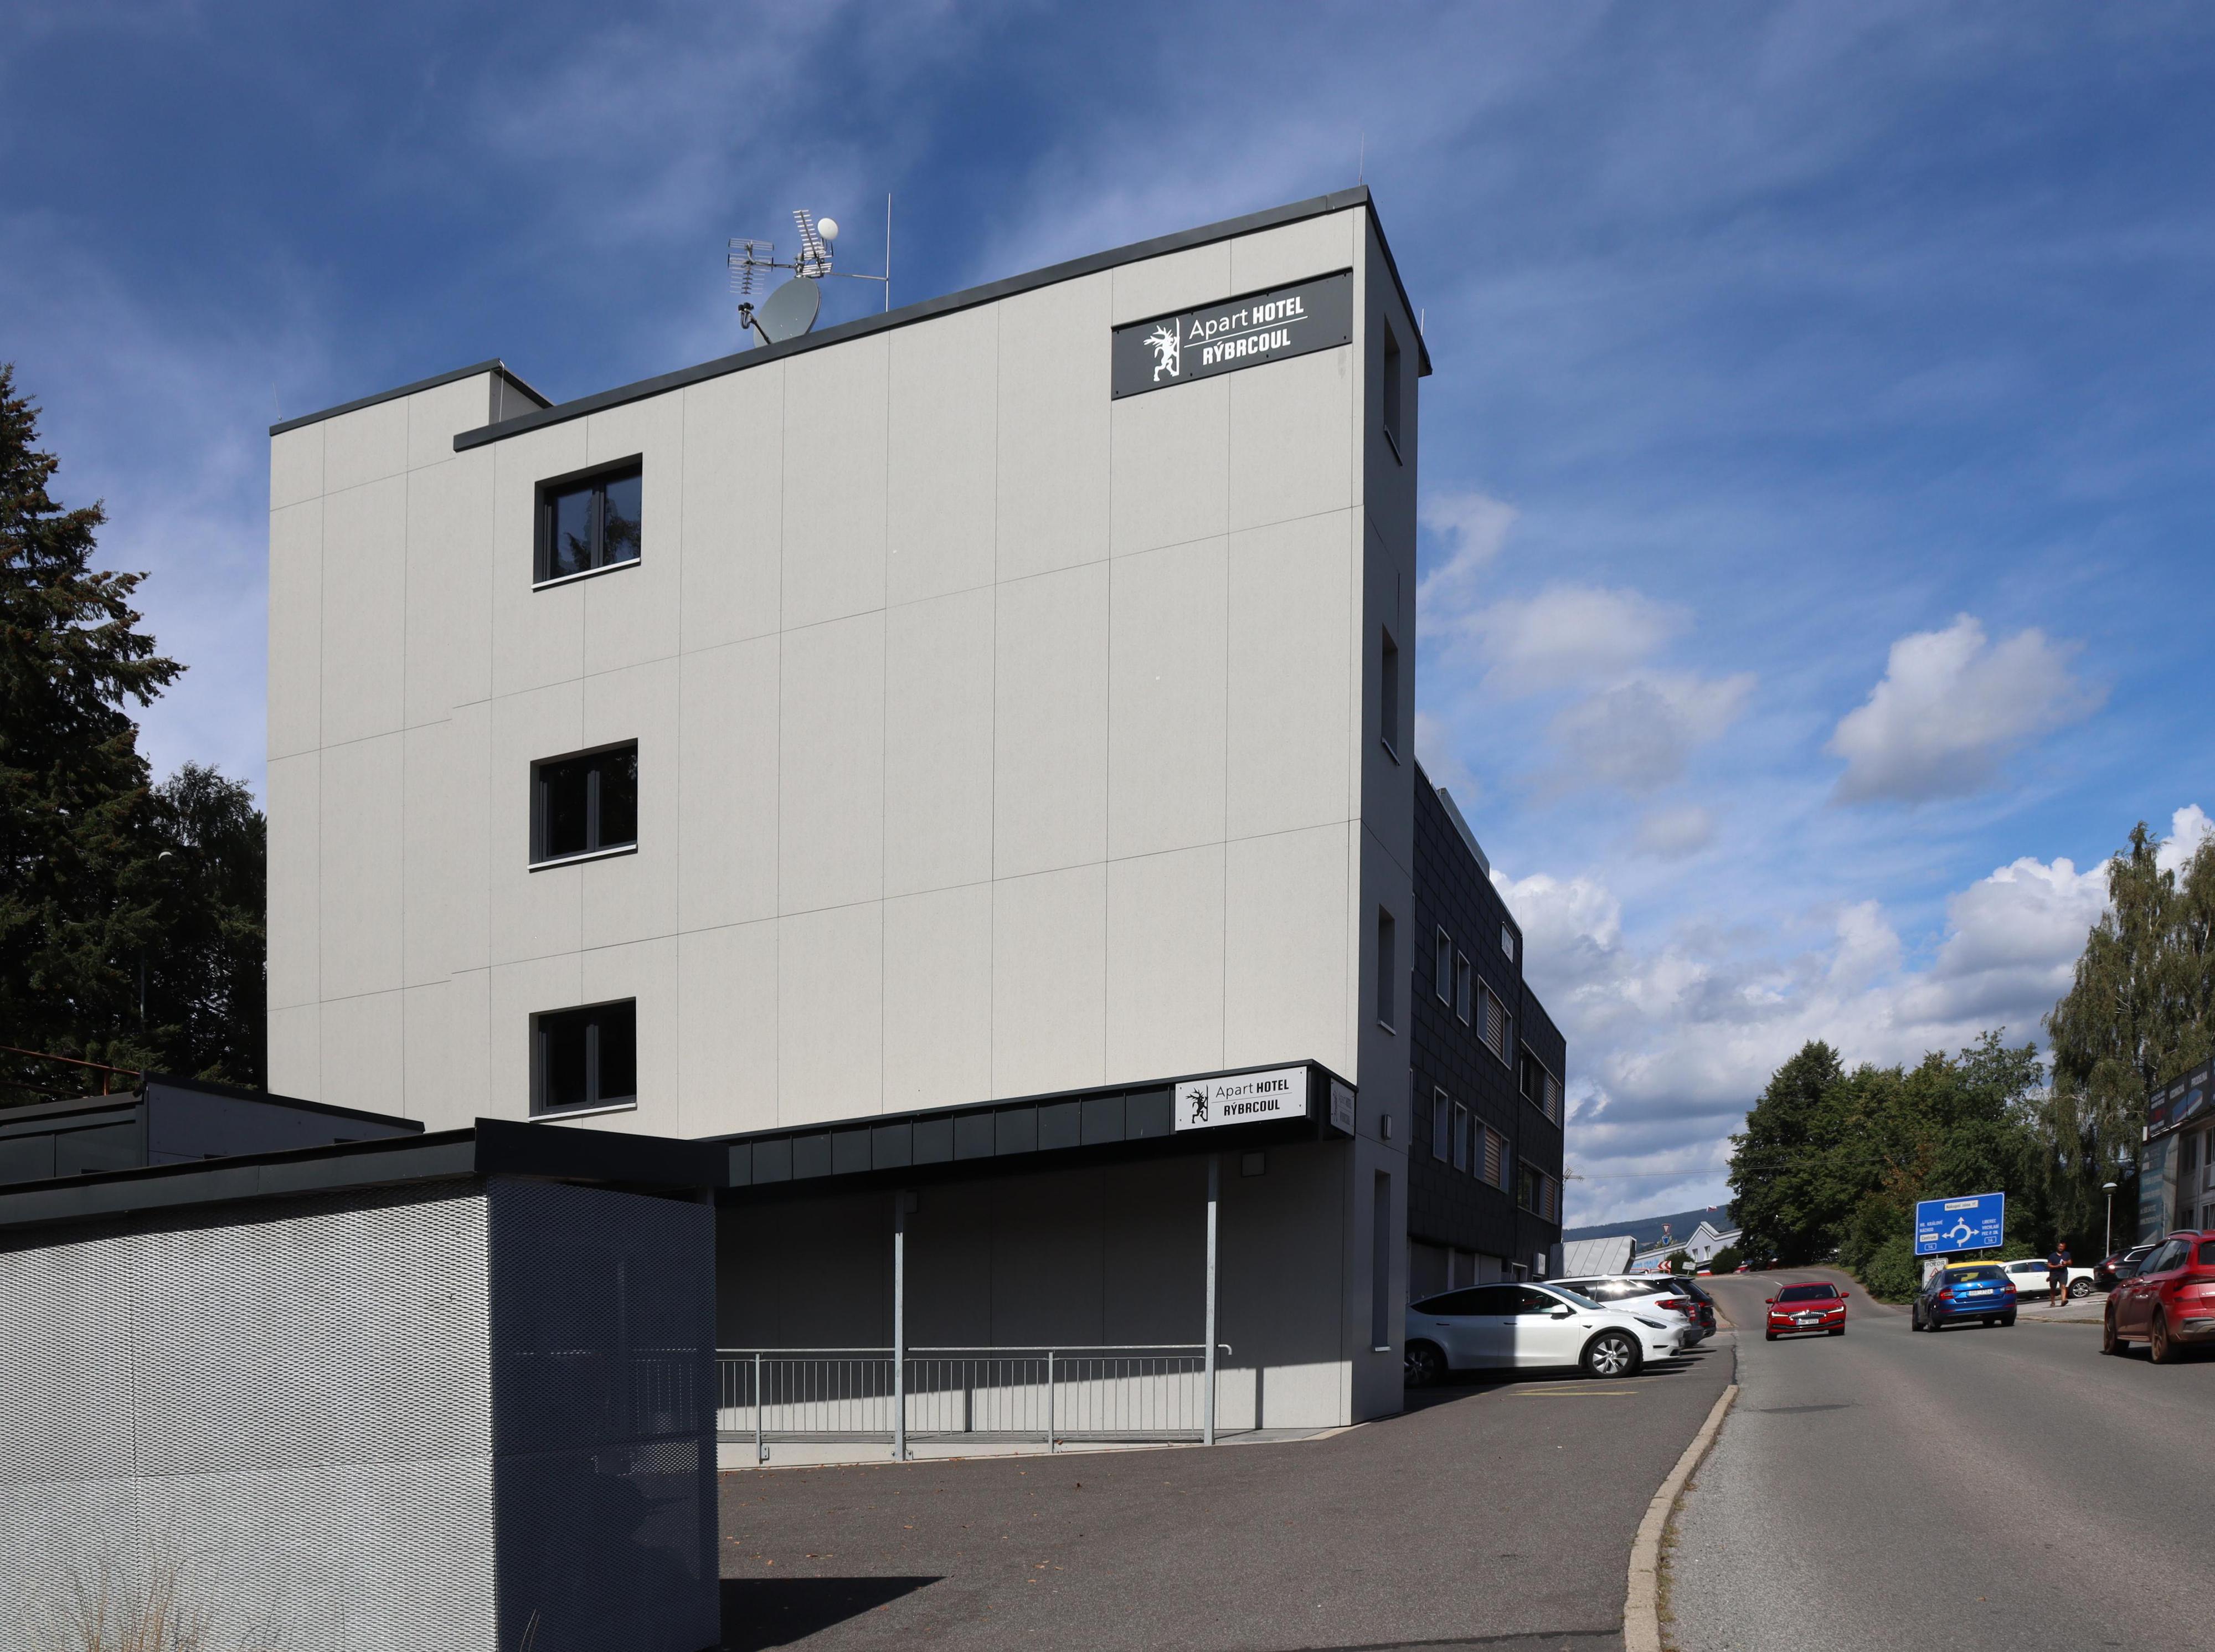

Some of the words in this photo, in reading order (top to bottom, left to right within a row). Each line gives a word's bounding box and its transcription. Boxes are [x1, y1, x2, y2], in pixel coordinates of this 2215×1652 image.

[1189, 309, 1248, 340] Apart
[1253, 296, 1304, 325] HOTEL
[1203, 328, 1291, 366] RÝBRCOUL
[1215, 1083, 1253, 1100] Apart
[1256, 1079, 1289, 1093] HOTEL
[1224, 1099, 1280, 1116] RÝBRCOUL
